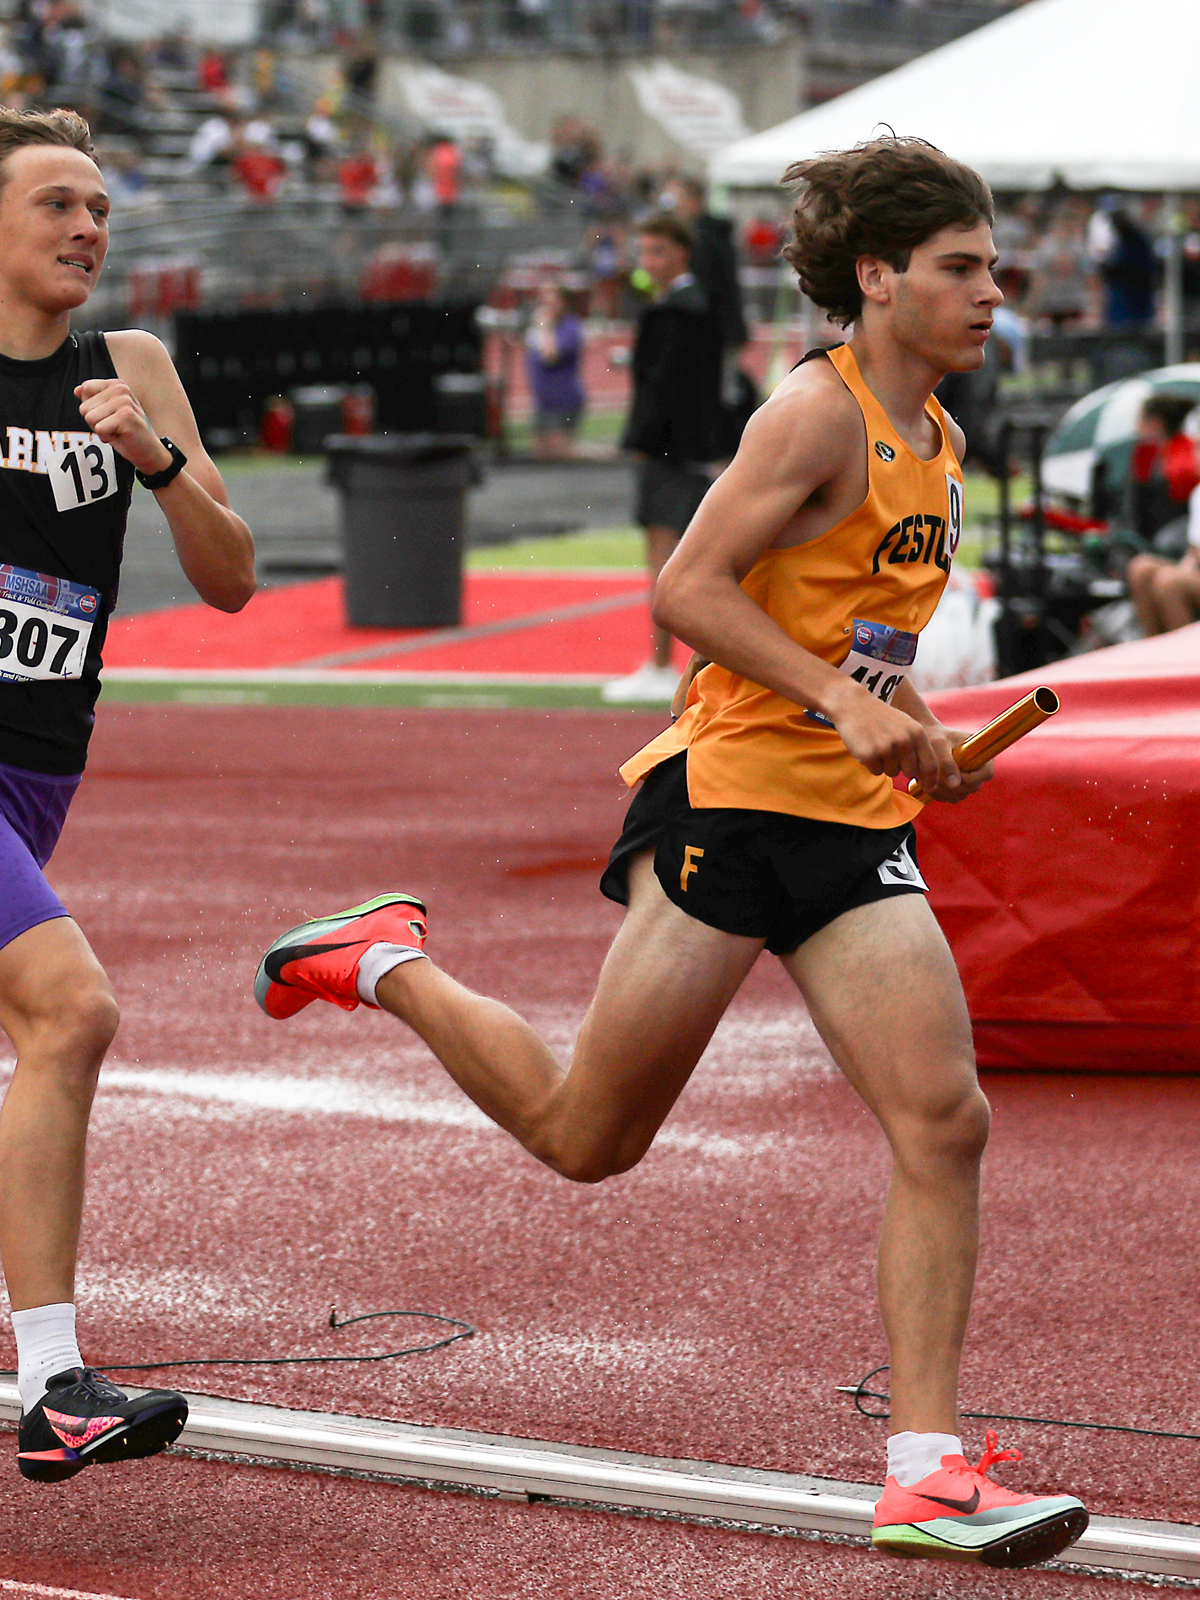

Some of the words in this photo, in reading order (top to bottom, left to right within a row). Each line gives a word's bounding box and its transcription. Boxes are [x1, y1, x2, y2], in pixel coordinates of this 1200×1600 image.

[60, 444, 109, 504] 13
[949, 483, 960, 554] 9
[872, 514, 951, 575] FESTU
[2, 590, 17, 600] Track
[24, 596, 36, 604] Field
[6, 574, 48, 598] MSHSAA
[3, 671, 15, 680] and
[680, 845, 704, 892] F
